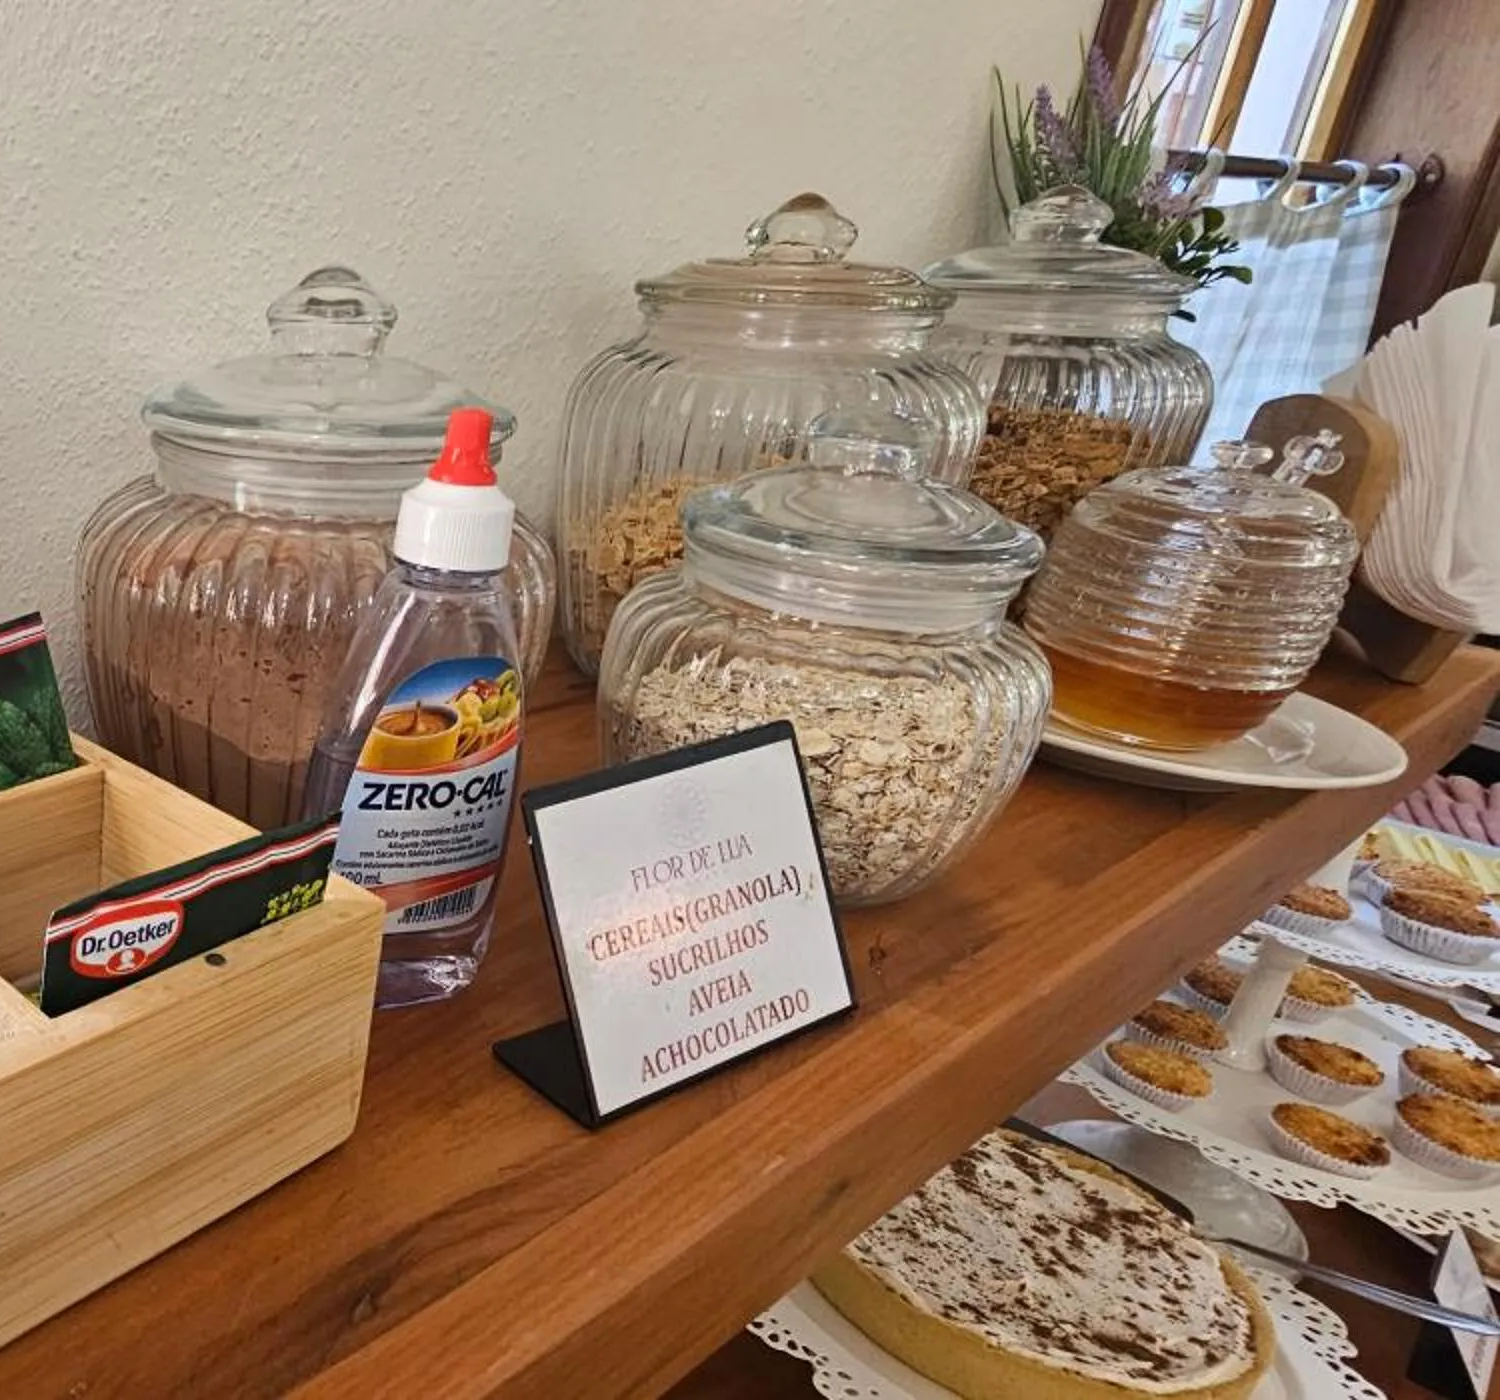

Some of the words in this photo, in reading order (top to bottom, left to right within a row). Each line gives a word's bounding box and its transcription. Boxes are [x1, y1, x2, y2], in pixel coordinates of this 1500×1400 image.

[630, 855, 684, 892] FLOR
[688, 845, 712, 874] DE
[648, 919, 770, 987] SUCRILHOS
[687, 969, 754, 1017] AVEIA
[640, 988, 811, 1083] ACHOCOLATADO
